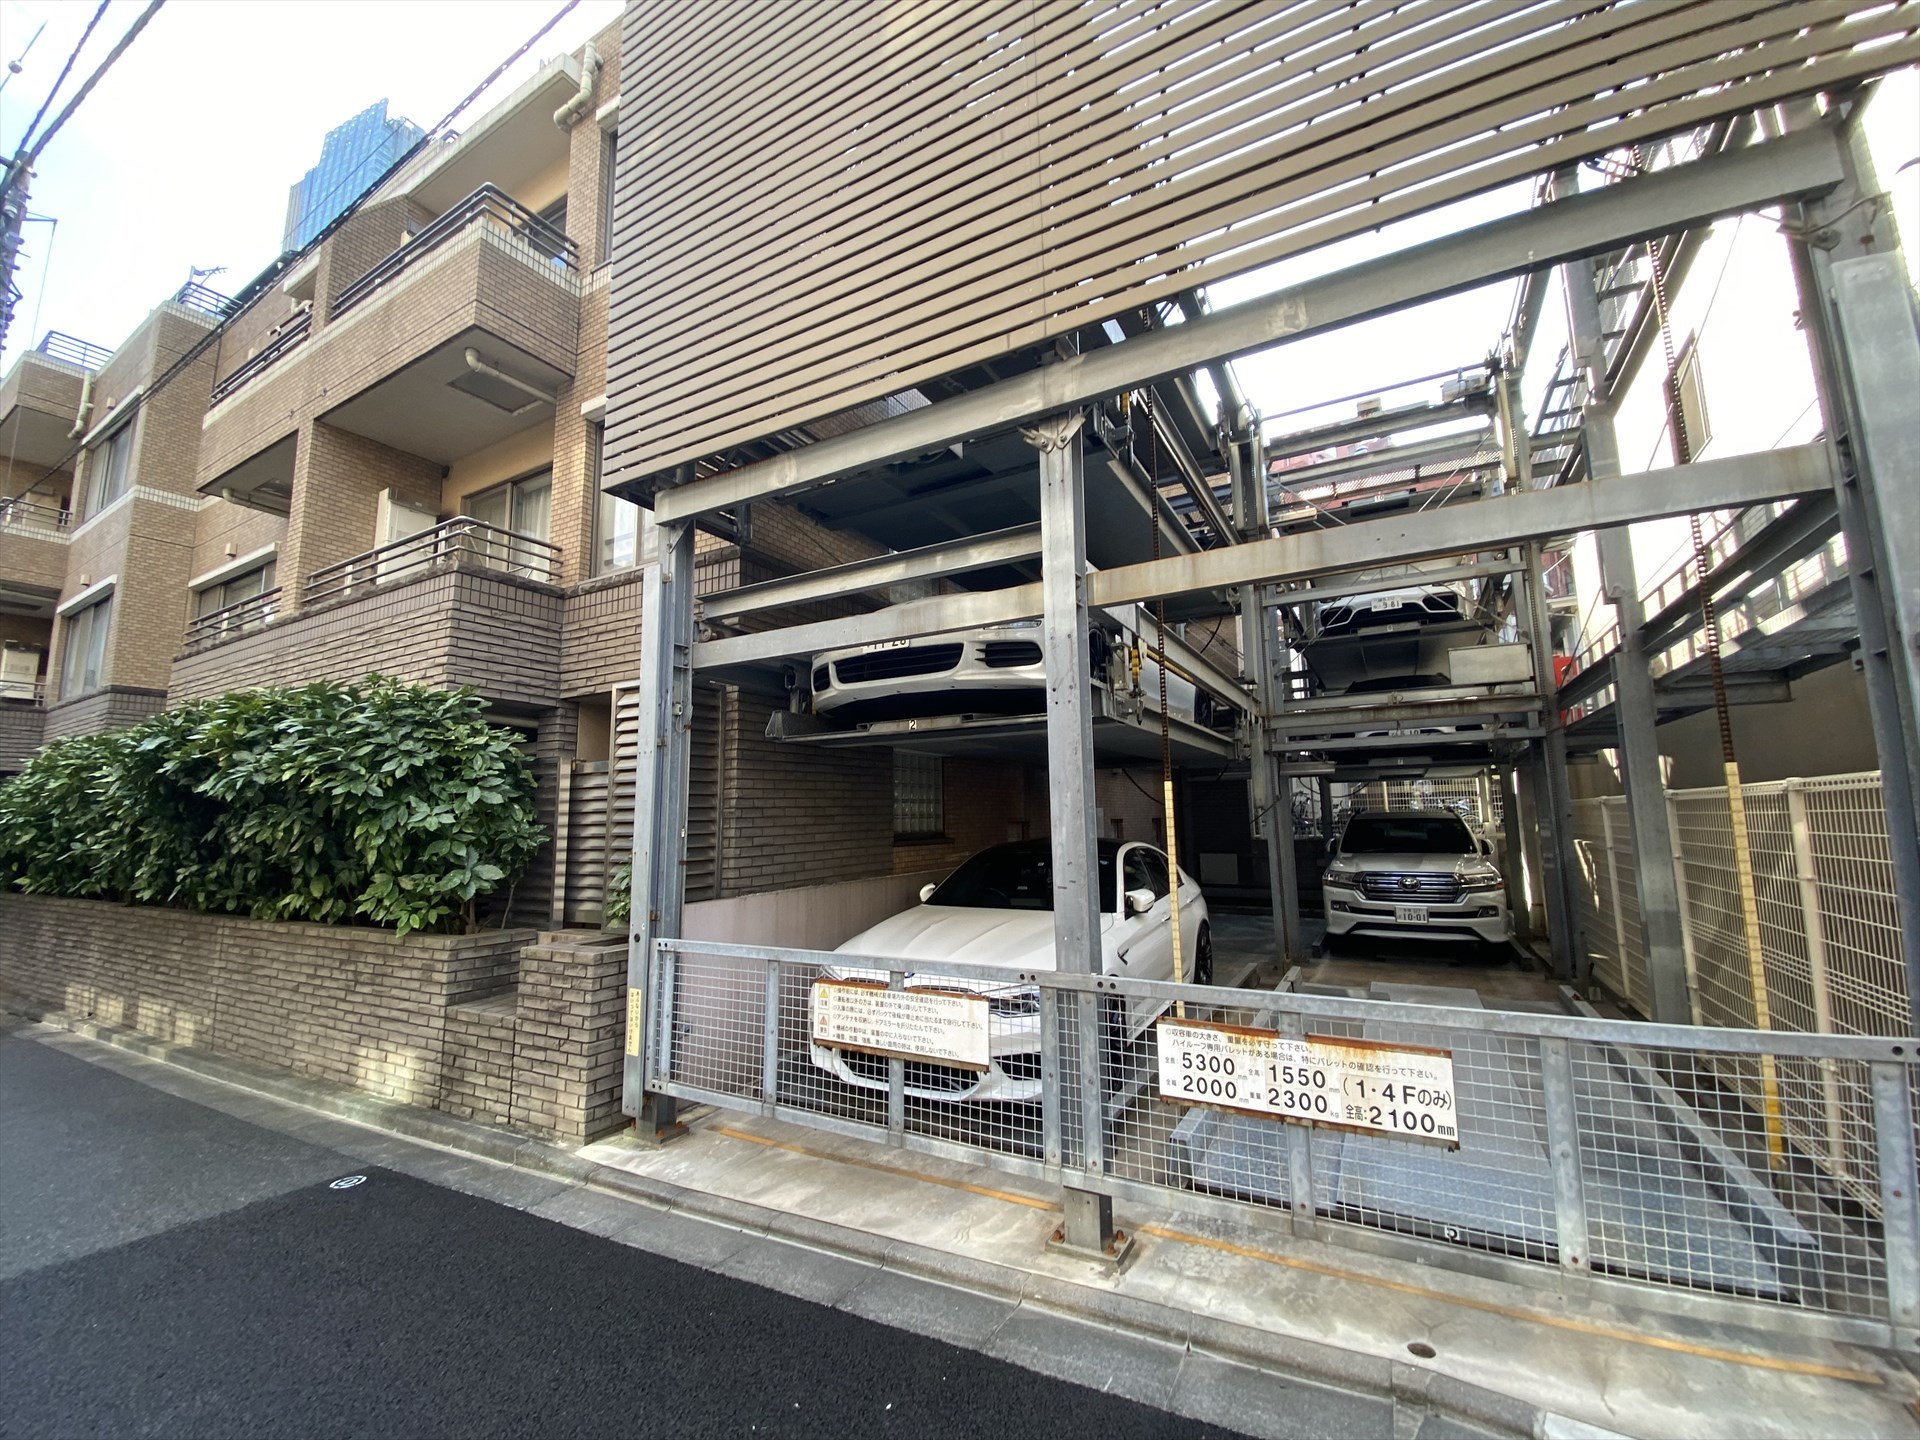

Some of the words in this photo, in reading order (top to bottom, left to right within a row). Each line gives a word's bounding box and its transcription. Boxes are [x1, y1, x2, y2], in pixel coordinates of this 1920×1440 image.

[910, 719, 916, 730] 2
[1182, 1051, 1236, 1076] 5300
[1183, 1074, 1237, 1099] 2000
[1268, 1063, 1326, 1090] 1550
[1328, 1086, 1341, 1094] mm
[1268, 1087, 1328, 1114] 2300
[1330, 1110, 1340, 1119] kg
